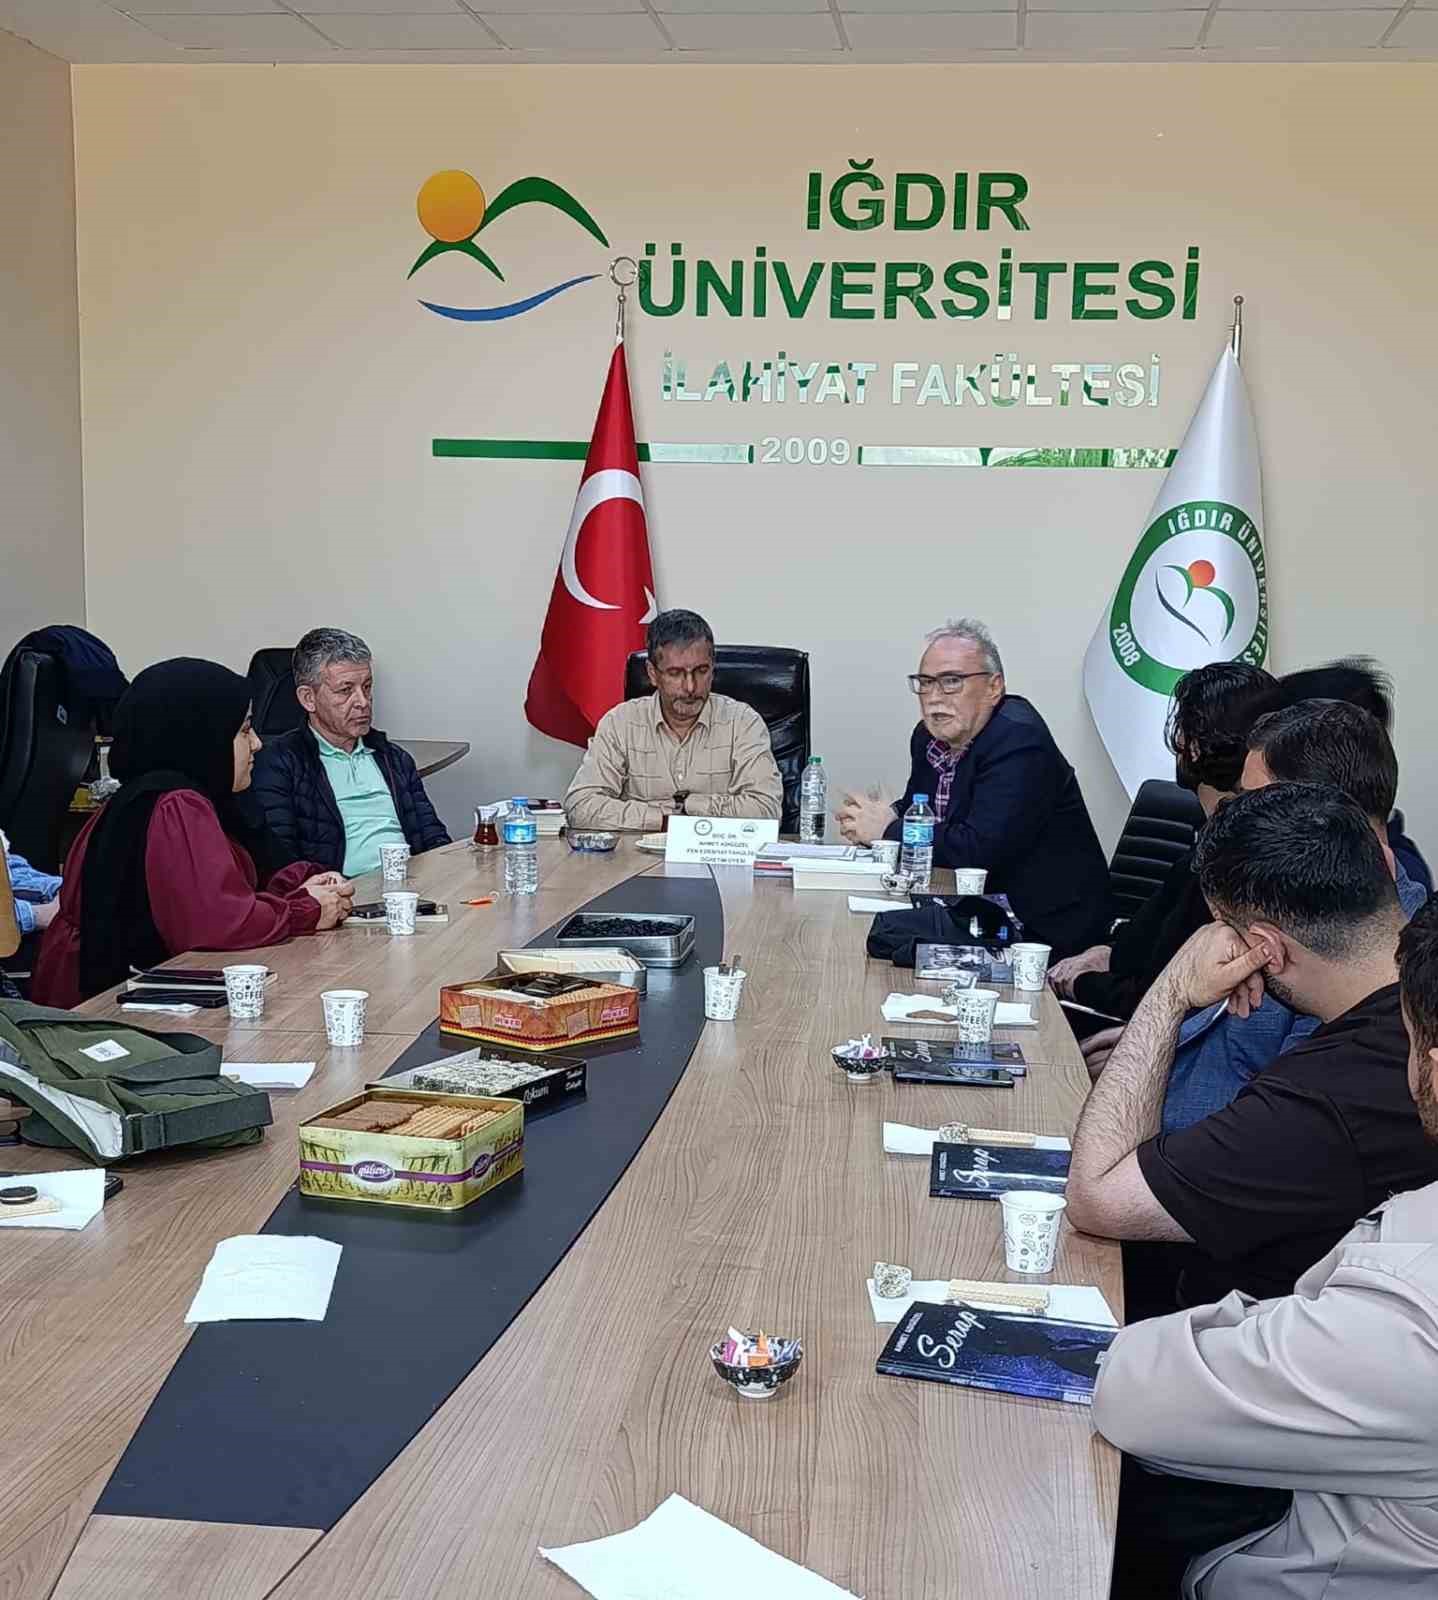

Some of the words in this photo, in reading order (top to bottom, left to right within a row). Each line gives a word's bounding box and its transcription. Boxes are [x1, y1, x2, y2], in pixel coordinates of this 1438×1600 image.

[807, 158, 1031, 231] IĞDIR
[637, 243, 1200, 320] ÜNİVERSİTESİ
[661, 345, 879, 405] İLAHİYAT
[891, 352, 1161, 408] FAKÜLTESİ
[760, 436, 851, 466] 2009
[1167, 508, 1234, 535] IĞDIR
[1112, 622, 1142, 667] 2008
[917, 1310, 987, 1369] Serap
